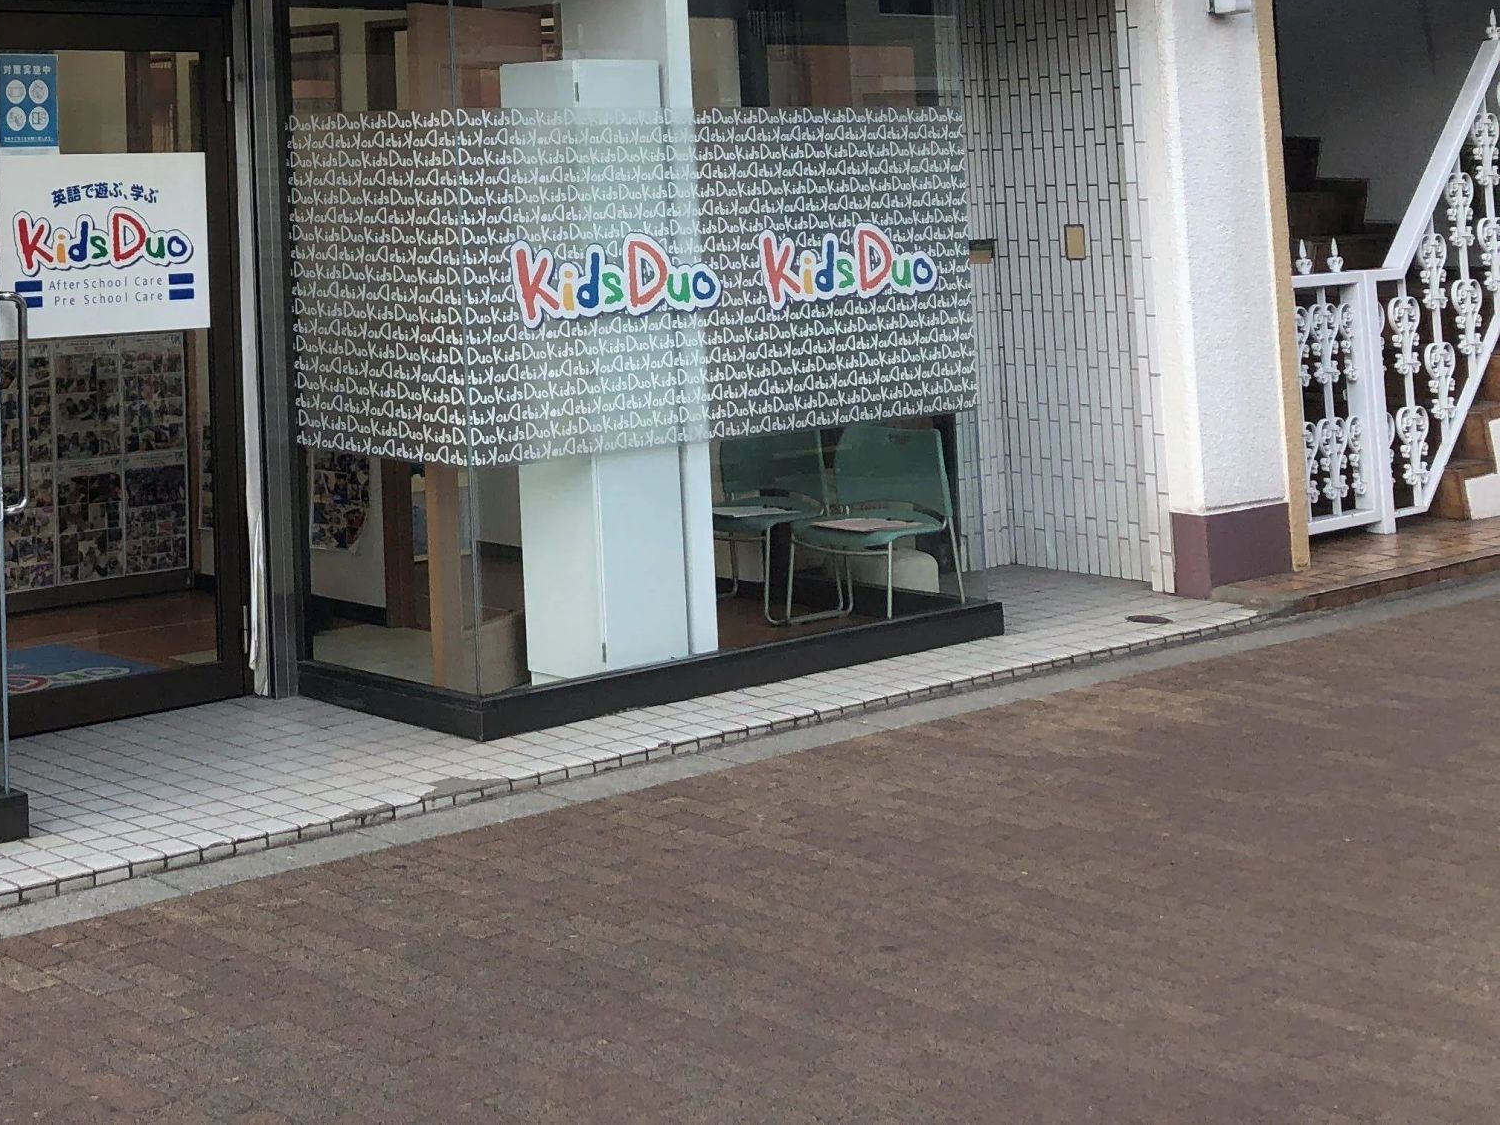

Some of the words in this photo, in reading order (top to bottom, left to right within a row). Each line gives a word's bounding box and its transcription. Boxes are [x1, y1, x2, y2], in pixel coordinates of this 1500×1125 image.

[51, 181, 159, 208] 英語で遊ぶ、学ぶ
[135, 275, 163, 287] Care
[54, 294, 76, 306] Pre
[84, 292, 128, 305] School
[135, 290, 163, 303] Care
